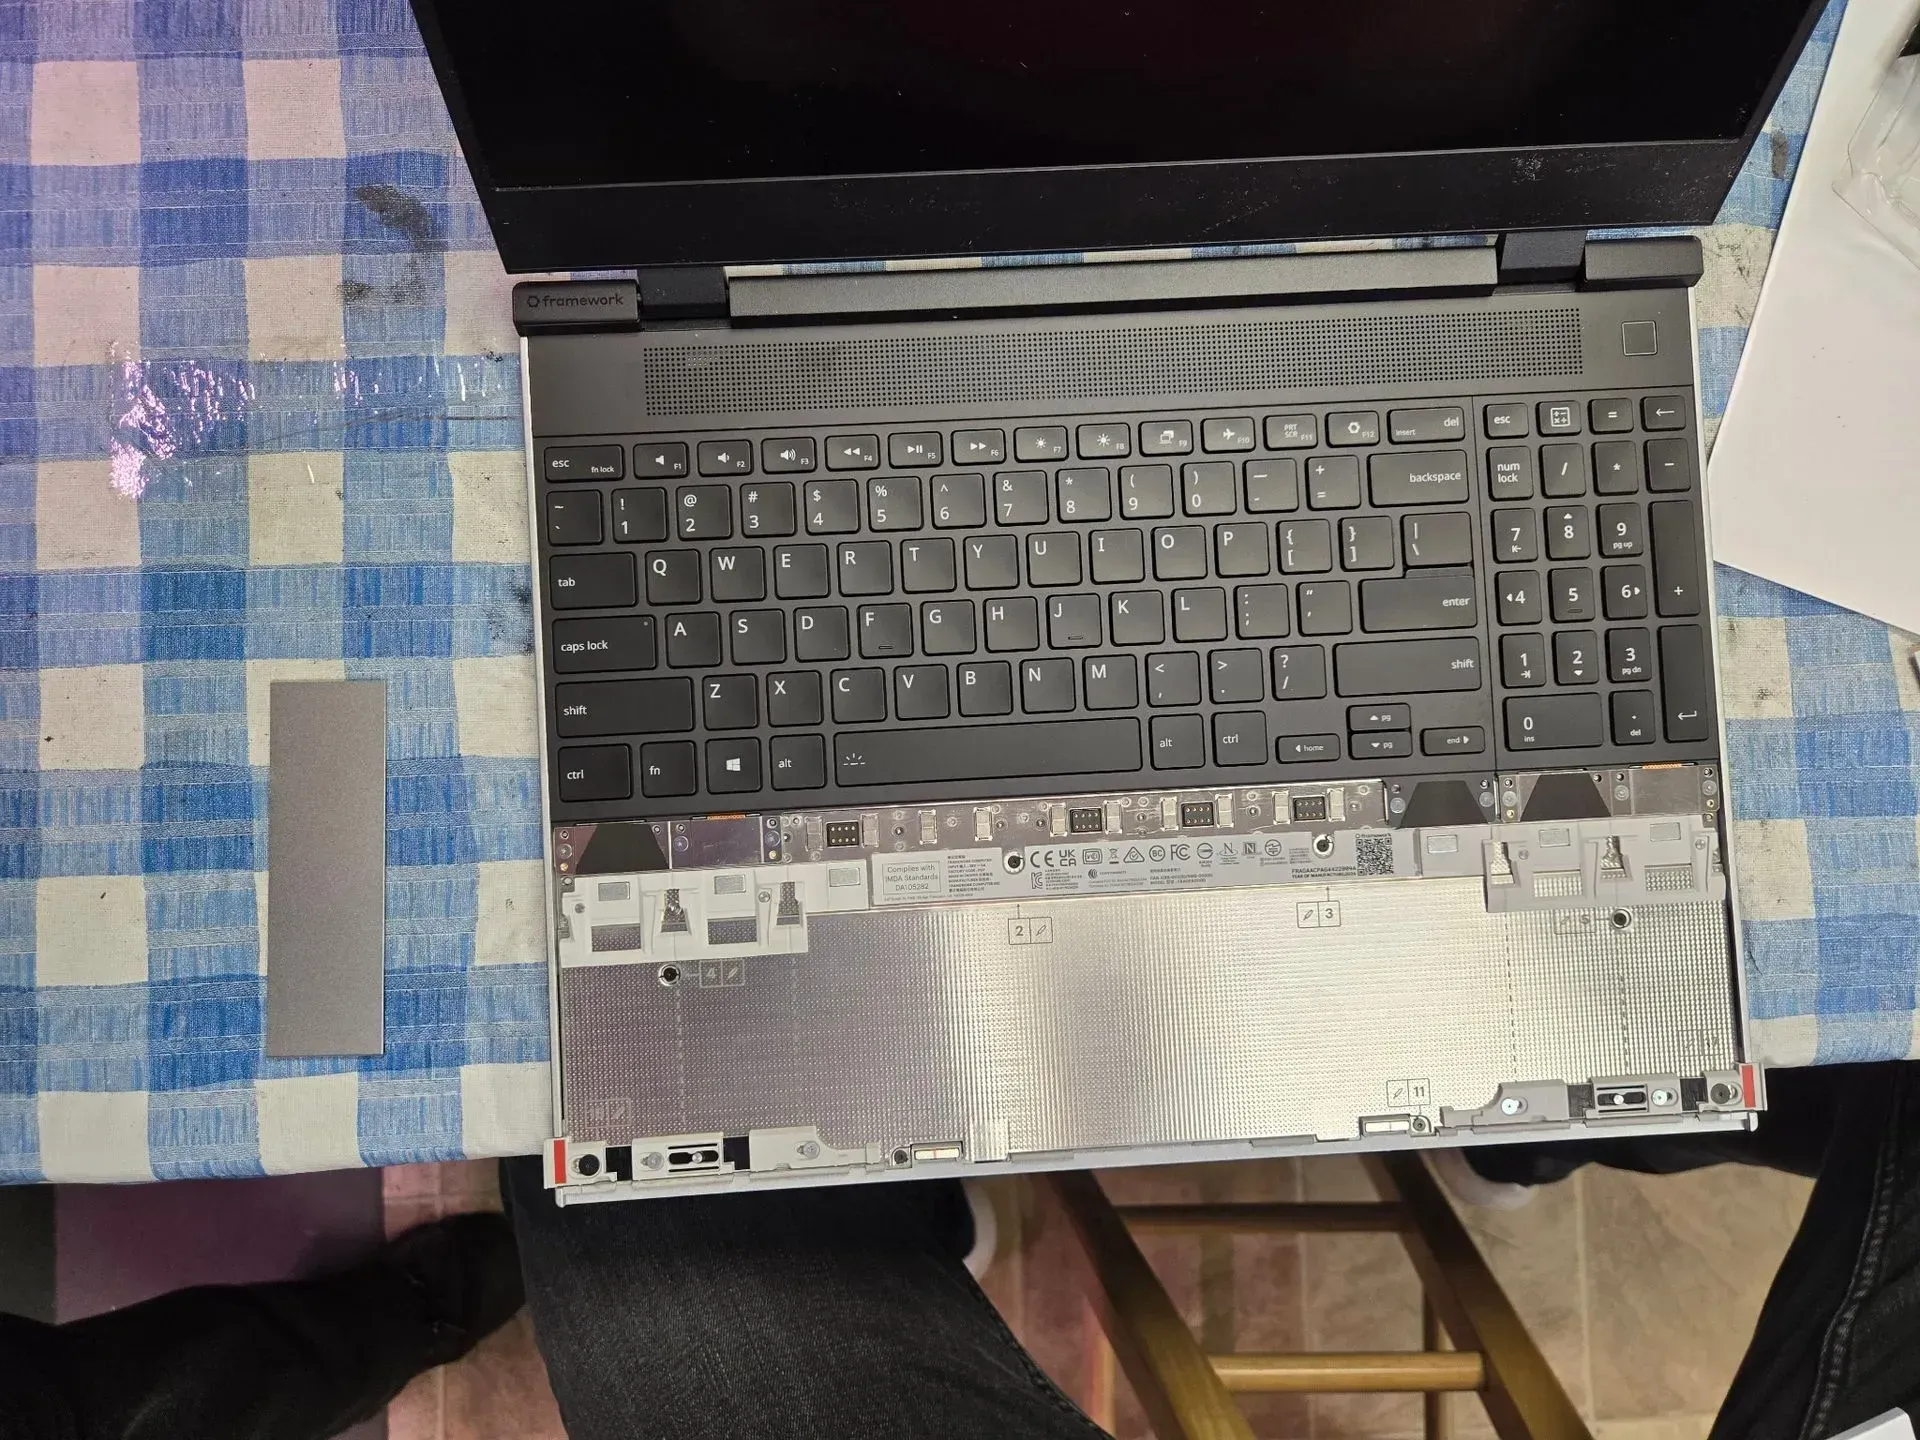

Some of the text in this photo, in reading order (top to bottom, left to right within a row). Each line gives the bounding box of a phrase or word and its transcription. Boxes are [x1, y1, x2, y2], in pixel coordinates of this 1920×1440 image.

[542, 294, 624, 307] framework
[1444, 417, 1459, 427] del
[1494, 416, 1510, 424] esc
[1285, 423, 1297, 431] PRT
[1301, 433, 1312, 441] F11
[928, 452, 936, 460] F5
[991, 449, 999, 457] F6
[674, 462, 681, 470] F1
[737, 460, 745, 468] F2
[801, 457, 809, 465] F3
[1498, 463, 1520, 471] num
[600, 465, 614, 473] lock
[1410, 473, 1461, 483] backspace
[1498, 473, 1518, 482] lock
[1067, 500, 1075, 513] 8
[1129, 497, 1137, 510] 9
[1192, 494, 1201, 507] 0
[878, 510, 886, 522] 5
[941, 507, 949, 520] 6
[1004, 504, 1012, 516] 7
[686, 519, 695, 532] 2
[750, 515, 758, 528] 3
[814, 513, 823, 525] 4
[621, 521, 628, 534] 1
[1565, 525, 1573, 538] 8
[1617, 523, 1626, 536] 9
[1224, 532, 1233, 545] P
[1511, 528, 1520, 541] 7
[1035, 541, 1046, 555] U
[1097, 538, 1105, 551] I
[1161, 534, 1174, 549] O
[1613, 541, 1632, 550] pg up
[846, 551, 856, 564] R
[909, 548, 919, 561] T
[973, 545, 982, 558] Y
[718, 556, 735, 570] W
[782, 554, 790, 567] E
[653, 559, 666, 576] Q
[558, 578, 575, 586] tab
[1515, 591, 1525, 603] 4
[1569, 588, 1578, 601] 5
[1622, 585, 1631, 598] 6
[1119, 600, 1129, 613] K
[1181, 597, 1190, 610] L
[1443, 598, 1470, 606] enter
[930, 610, 941, 623] G
[992, 607, 1003, 620] H
[1054, 603, 1062, 617] J
[802, 616, 813, 629] D
[866, 612, 874, 626] F
[674, 622, 686, 636] A
[738, 619, 748, 633] S
[561, 640, 608, 653] caps lock
[1520, 653, 1528, 666] 1
[1573, 651, 1582, 664] 2
[1626, 648, 1635, 661] 3
[1451, 659, 1474, 669] shift
[1029, 667, 1040, 681] N
[1092, 664, 1106, 678] M
[839, 678, 849, 691] C
[903, 675, 914, 688] V
[966, 671, 976, 685] B
[710, 684, 721, 698] Z
[775, 681, 786, 695] X
[564, 705, 587, 715] shift
[1382, 714, 1391, 722] pg
[1524, 717, 1533, 730] 0
[1160, 738, 1172, 747] alt
[1223, 734, 1238, 743] ctrl
[1384, 741, 1392, 749] pg
[1524, 735, 1534, 743] ins
[1304, 744, 1323, 752] home
[779, 759, 791, 768] alt
[567, 770, 583, 779] ctrl
[649, 766, 660, 775] fn
[1030, 850, 1055, 868] CE
[1059, 849, 1076, 858] UK
[887, 864, 935, 874] Complies with
[885, 874, 902, 883] IMDA
[903, 872, 939, 882] Standards
[895, 883, 929, 892] DA105282
[1324, 908, 1333, 919] 3
[1015, 925, 1024, 936] 2
[1413, 1086, 1426, 1097] 11
